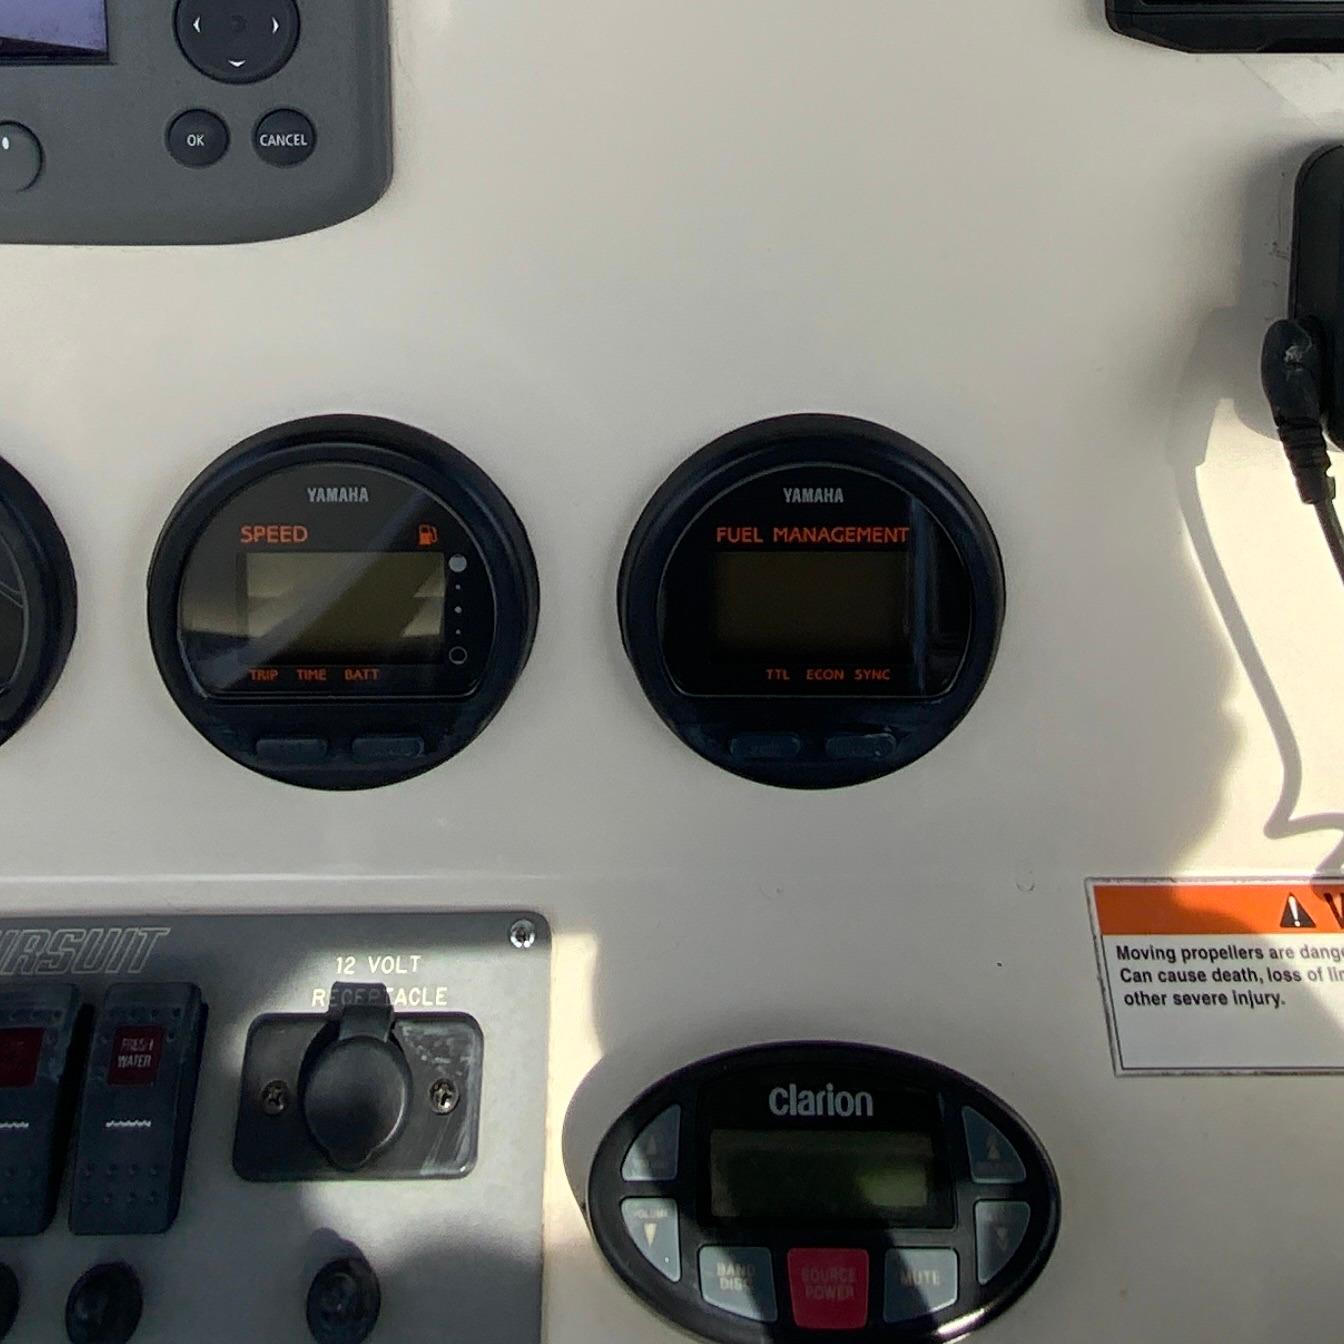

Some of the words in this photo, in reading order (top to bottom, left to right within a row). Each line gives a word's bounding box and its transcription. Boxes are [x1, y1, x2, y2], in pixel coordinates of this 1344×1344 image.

[187, 133, 205, 147] OK
[259, 132, 308, 147] CANCEL
[307, 487, 369, 503] YAMAHA
[783, 487, 844, 504] YAMAHA
[239, 525, 308, 543] SPEED
[716, 526, 764, 543] FUEL
[772, 526, 909, 544] MANAGEMENT
[248, 668, 279, 682] TRIP
[296, 668, 327, 682] TIME
[344, 668, 380, 682] BATT
[766, 668, 790, 681] TTL
[806, 668, 844, 682] ECON
[854, 668, 891, 682] SYNC
[1116, 944, 1177, 963] Moving
[1181, 945, 1264, 964] propellers
[1269, 947, 1295, 961] are
[335, 956, 356, 975] 12
[368, 955, 422, 974] VOLT
[1120, 967, 1153, 983] Can
[1157, 969, 1207, 983] cause
[1211, 967, 1264, 985] death,
[1267, 967, 1302, 983] loss
[1307, 966, 1323, 982] of
[1124, 990, 1167, 1006] other
[1173, 992, 1228, 1007] severe
[1233, 990, 1286, 1010] injury.
[116, 1054, 152, 1069] WATER
[768, 1082, 874, 1118] Clarion
[801, 1267, 856, 1283] SOURCE
[901, 1268, 942, 1285] MUTE
[805, 1285, 854, 1300] POWER
